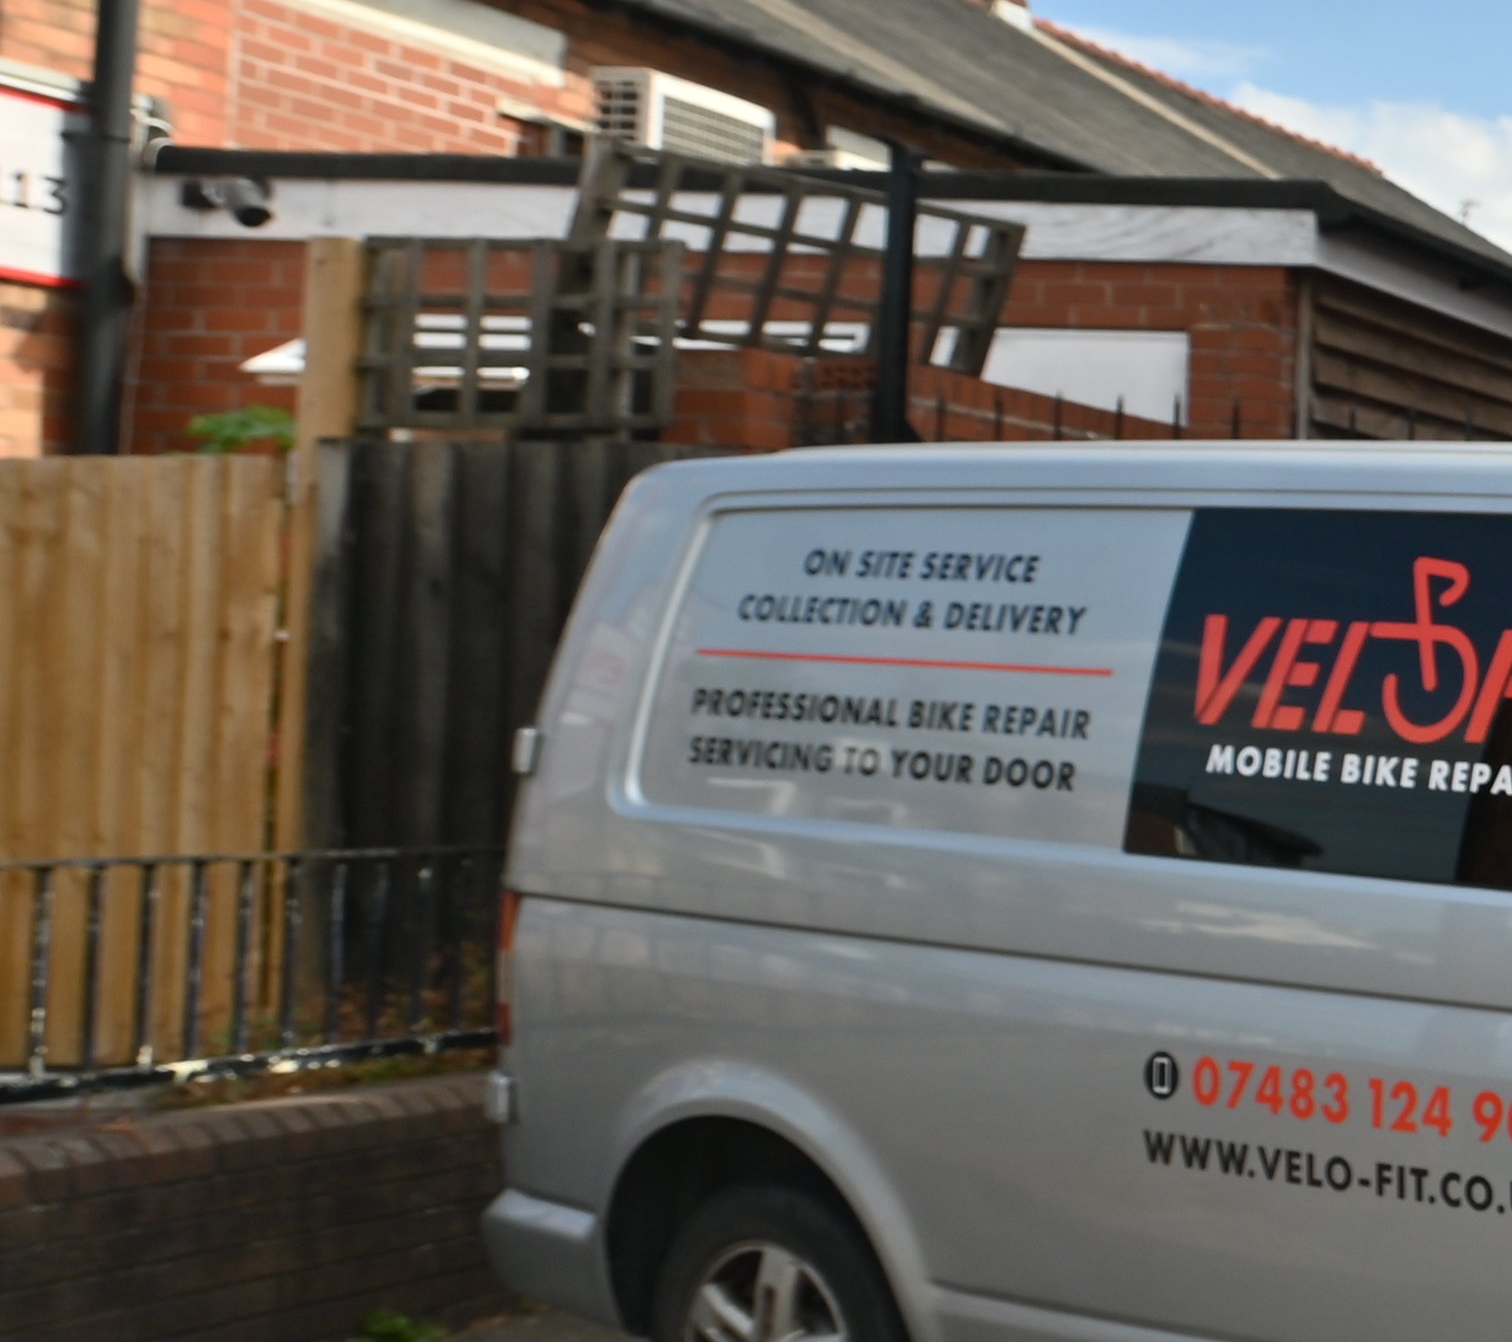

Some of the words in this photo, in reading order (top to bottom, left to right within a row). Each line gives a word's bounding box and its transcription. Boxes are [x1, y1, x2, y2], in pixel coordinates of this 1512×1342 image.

[803, 548, 850, 577] ON
[856, 550, 915, 580] SITE
[920, 552, 1040, 583] SERVICE
[738, 594, 908, 627] COLLECTION
[914, 600, 933, 629] &
[943, 602, 1087, 635] DELIVERY
[691, 688, 898, 727] PROFESSIONAL
[908, 700, 975, 731] BIKE
[982, 705, 1091, 740] REPAIR
[689, 735, 833, 773] SERVICING
[844, 746, 880, 776] TO
[890, 749, 973, 784] YOUR
[983, 756, 1075, 791] DOOR
[1206, 744, 1331, 782] MOBILE
[1341, 754, 1418, 790] BIKE
[1192, 1056, 1350, 1124] 07483
[1368, 1077, 1453, 1137] 124
